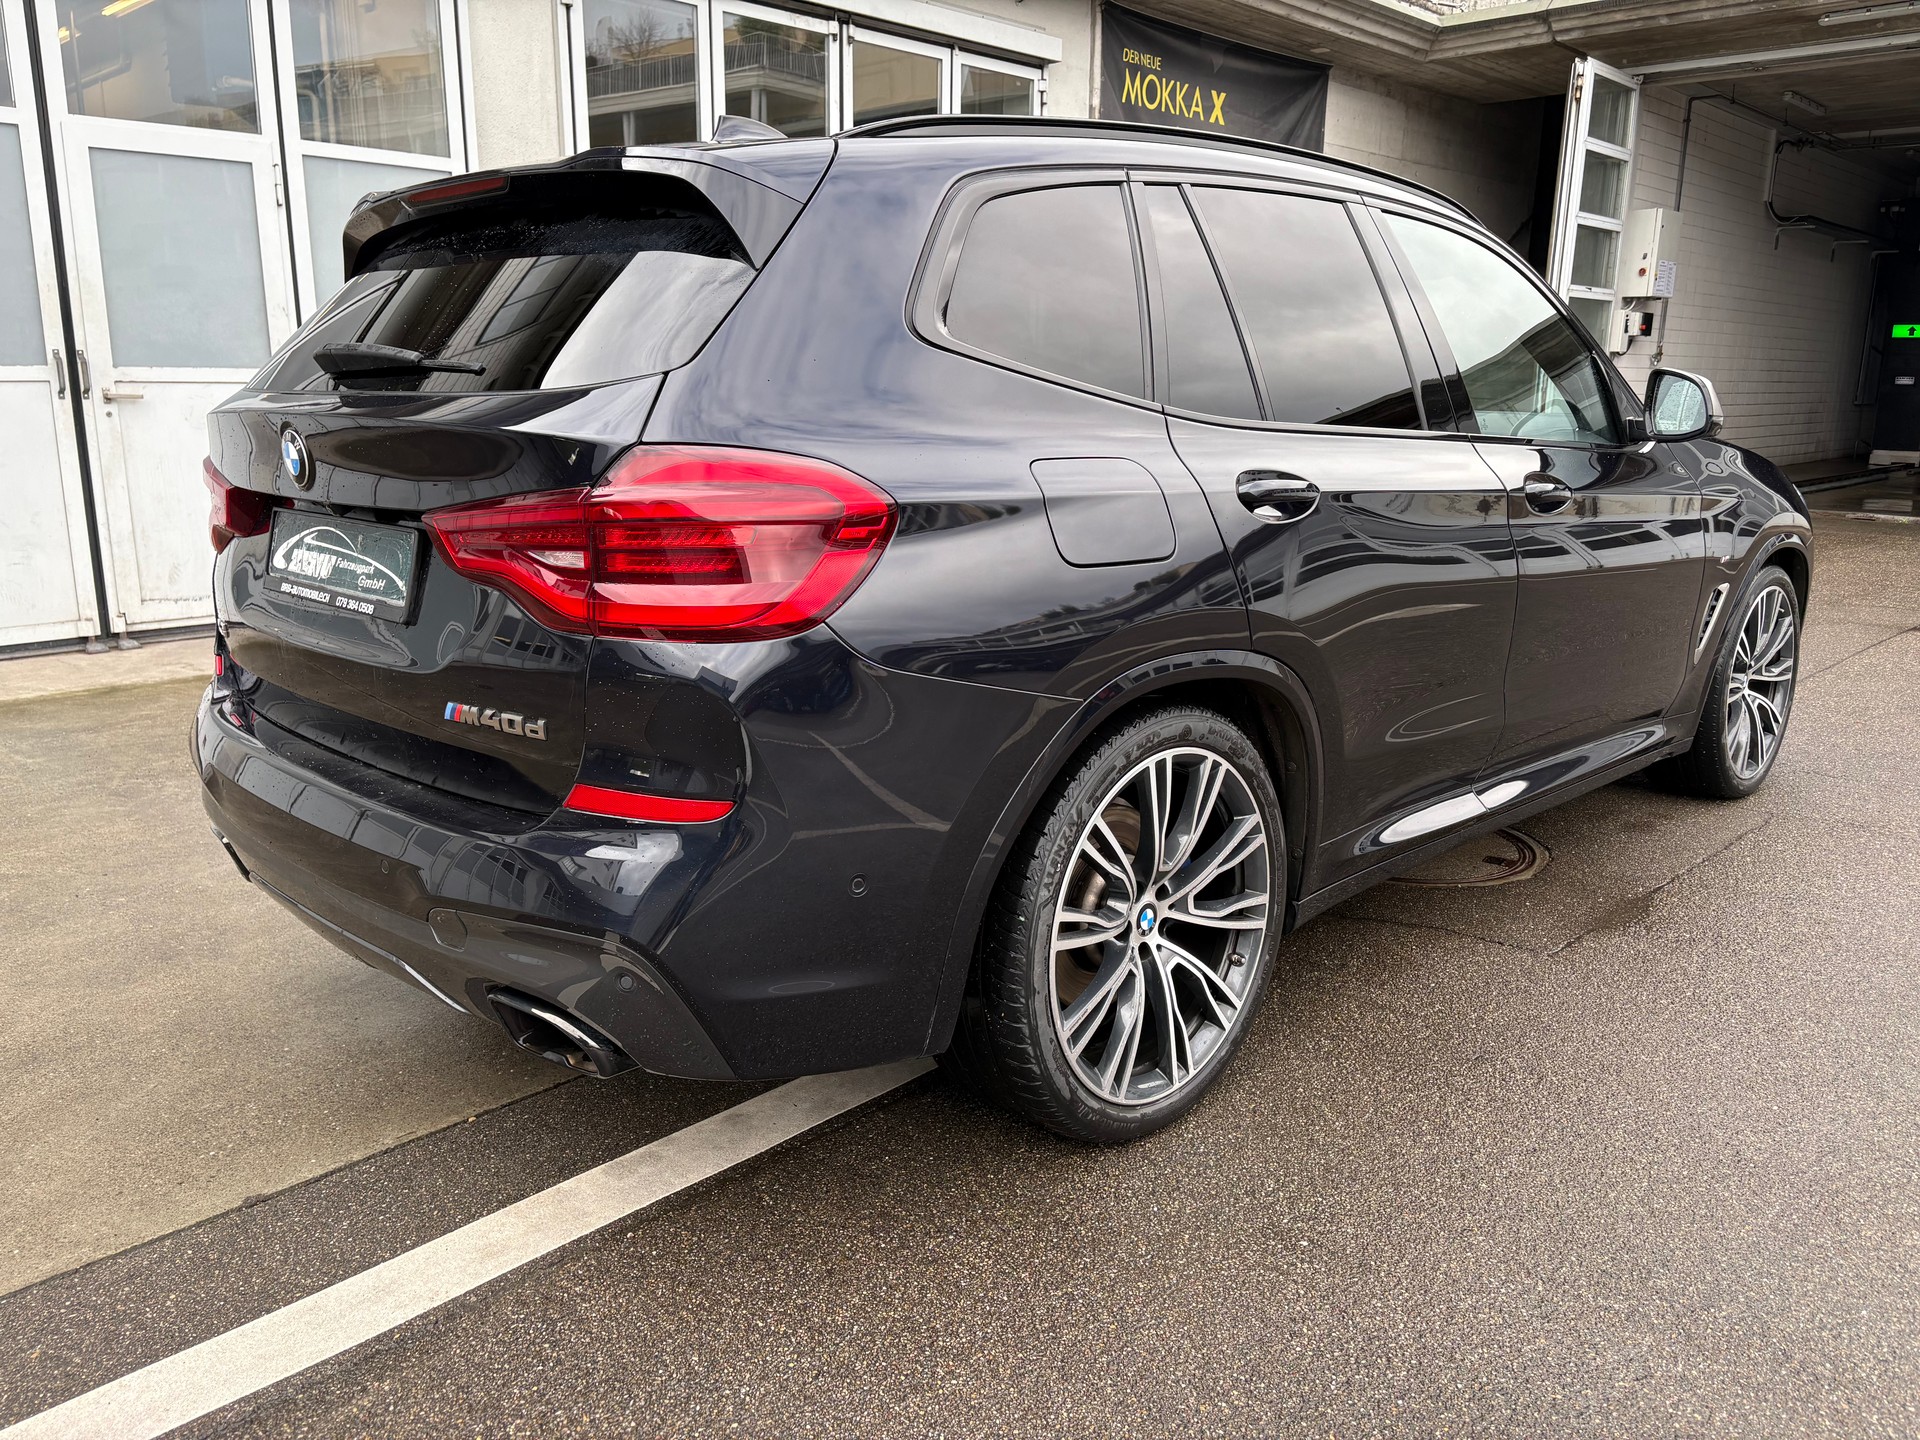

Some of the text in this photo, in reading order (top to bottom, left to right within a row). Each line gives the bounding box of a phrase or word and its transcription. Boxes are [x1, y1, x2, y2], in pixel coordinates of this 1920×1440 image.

[1122, 47, 1162, 71] DER NEUE
[1121, 67, 1227, 126] MOKKA X
[335, 557, 375, 575] Fahrzeugpark
[357, 575, 386, 591] GmbH
[335, 596, 375, 615] 079 364 0508
[459, 704, 547, 741] M40d
